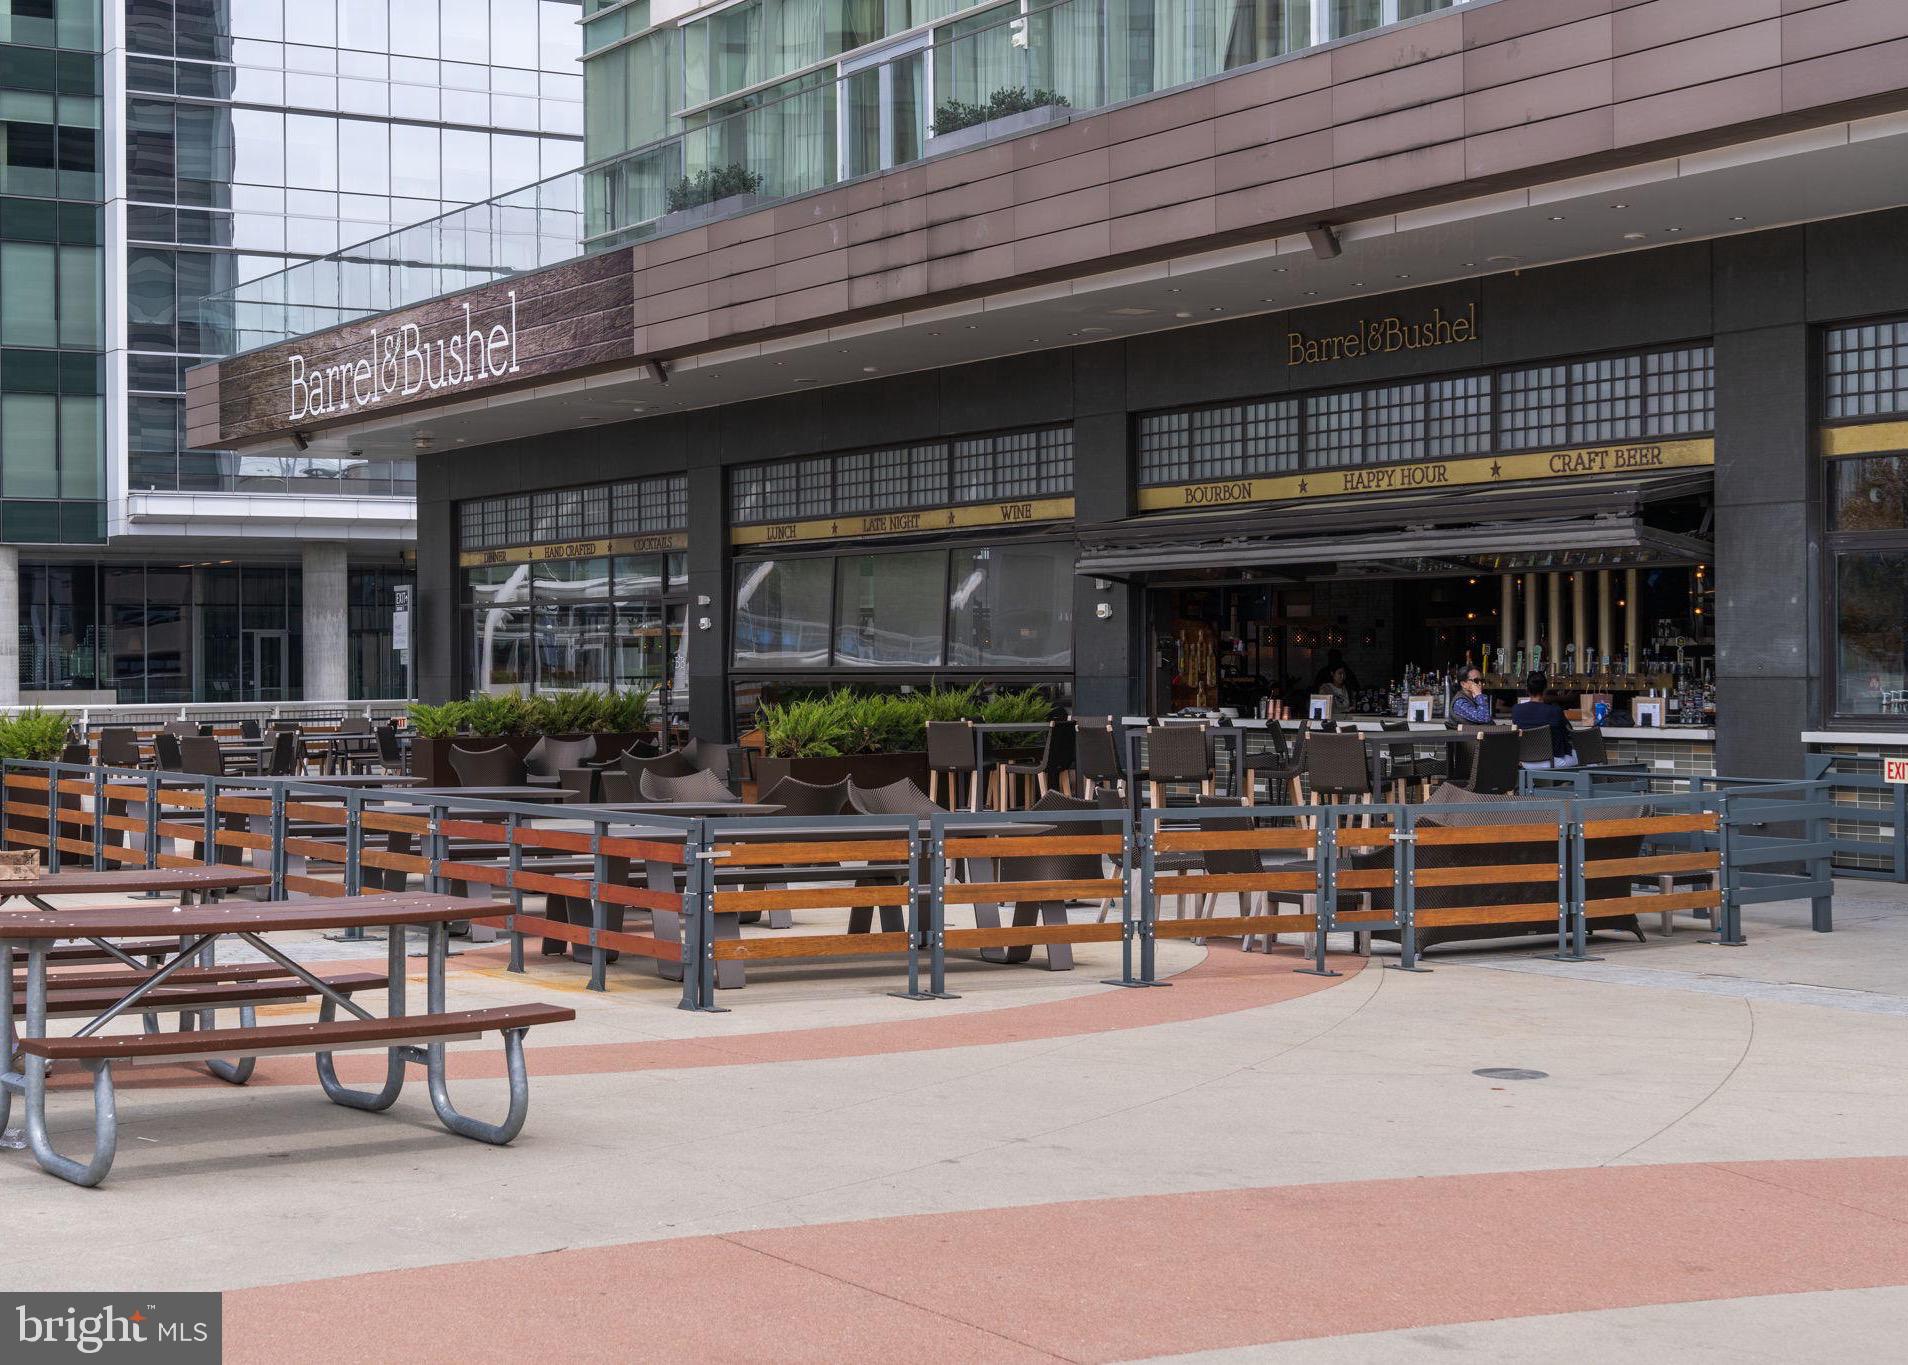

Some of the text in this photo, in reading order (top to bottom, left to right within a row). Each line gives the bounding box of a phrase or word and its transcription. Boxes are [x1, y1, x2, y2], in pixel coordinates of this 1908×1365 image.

[289, 291, 519, 420] Barrel&Bushel
[1287, 303, 1478, 366] Barrel&Bushel
[1184, 446, 1663, 504] BOURBON HAPPY HOUR CRAFT BEER
[483, 536, 673, 563] DINNER HAND CRAFTED COCKTAILS
[766, 503, 1032, 541] LUNCH LATE NIGHT WINE
